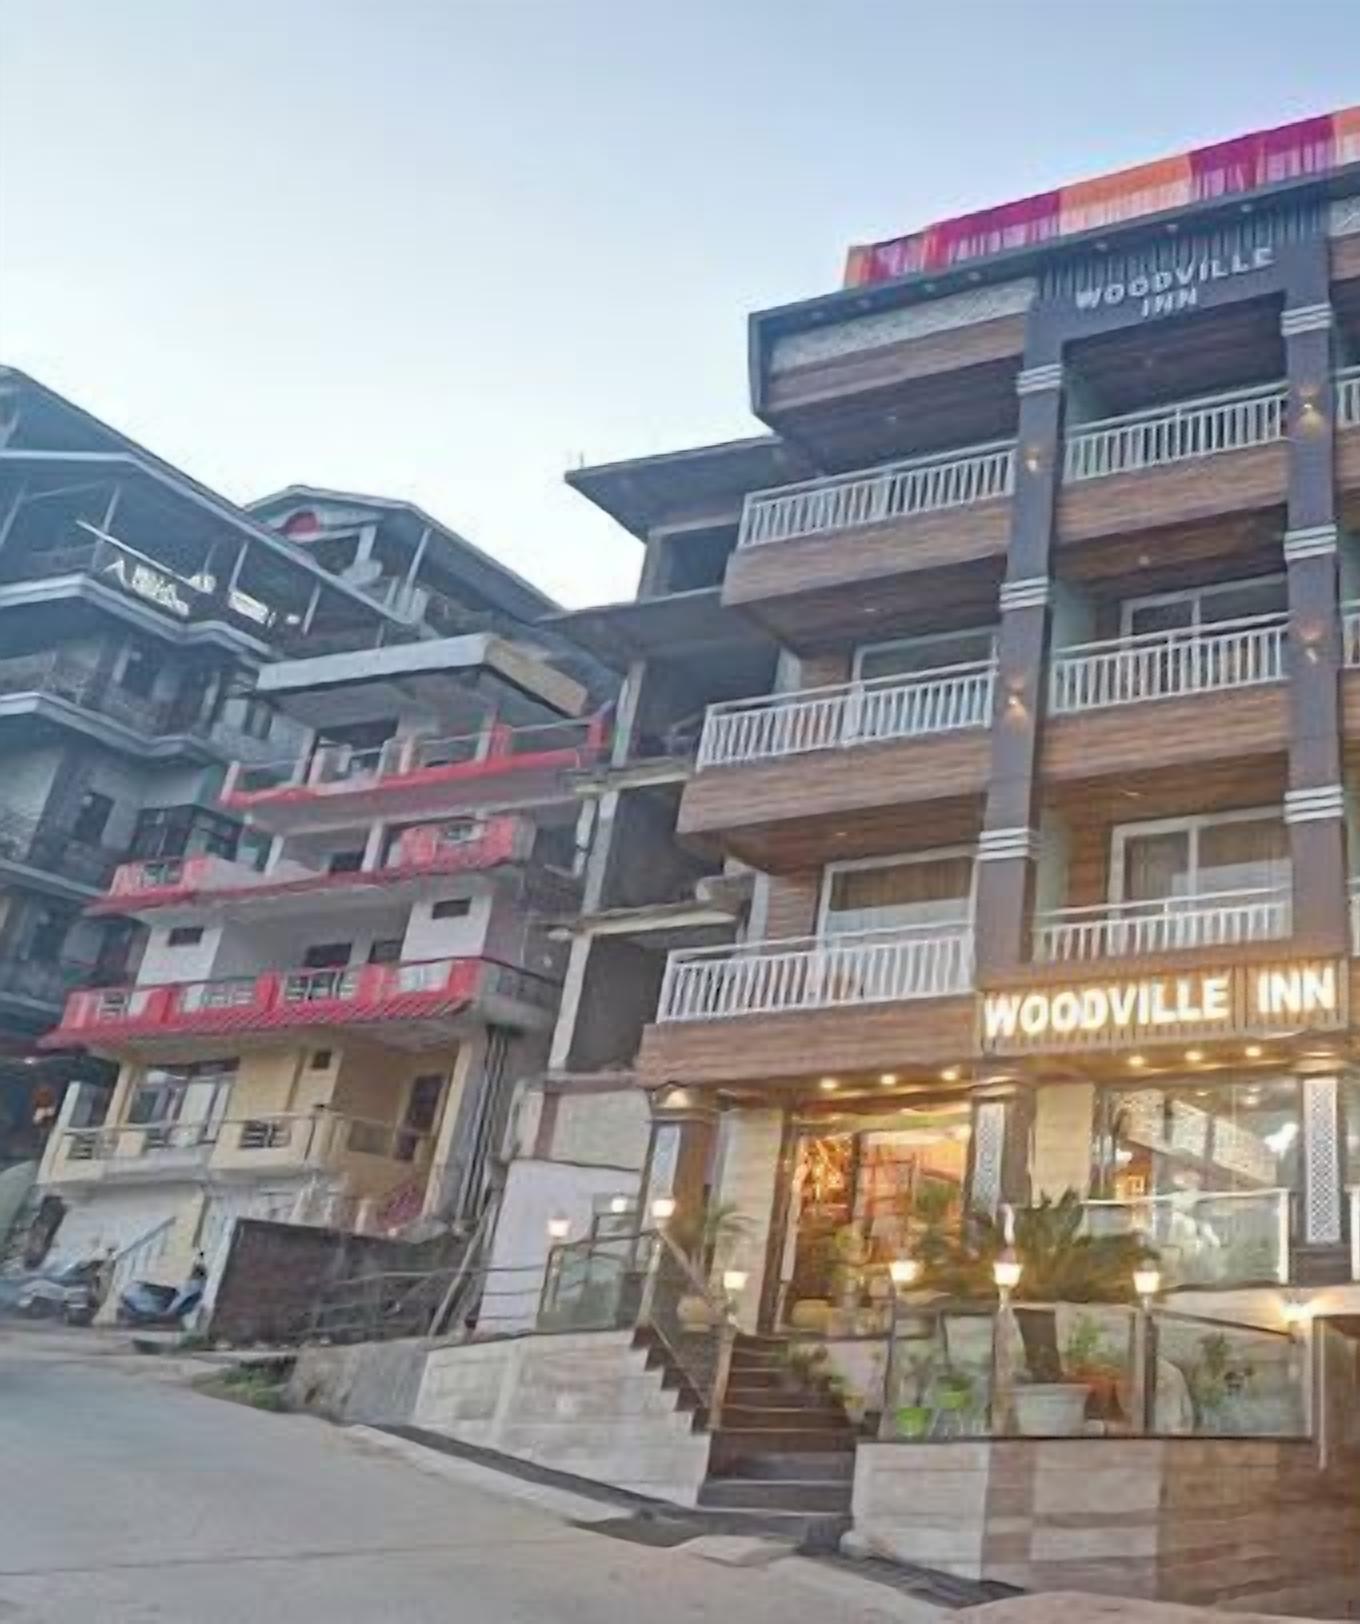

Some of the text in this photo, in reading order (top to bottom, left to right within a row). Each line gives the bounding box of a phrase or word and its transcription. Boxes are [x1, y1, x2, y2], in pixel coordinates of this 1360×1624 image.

[1075, 247, 1273, 309] WOODVILLE
[1141, 287, 1198, 317] INN
[984, 965, 1336, 1039] WOODVILLE INN
